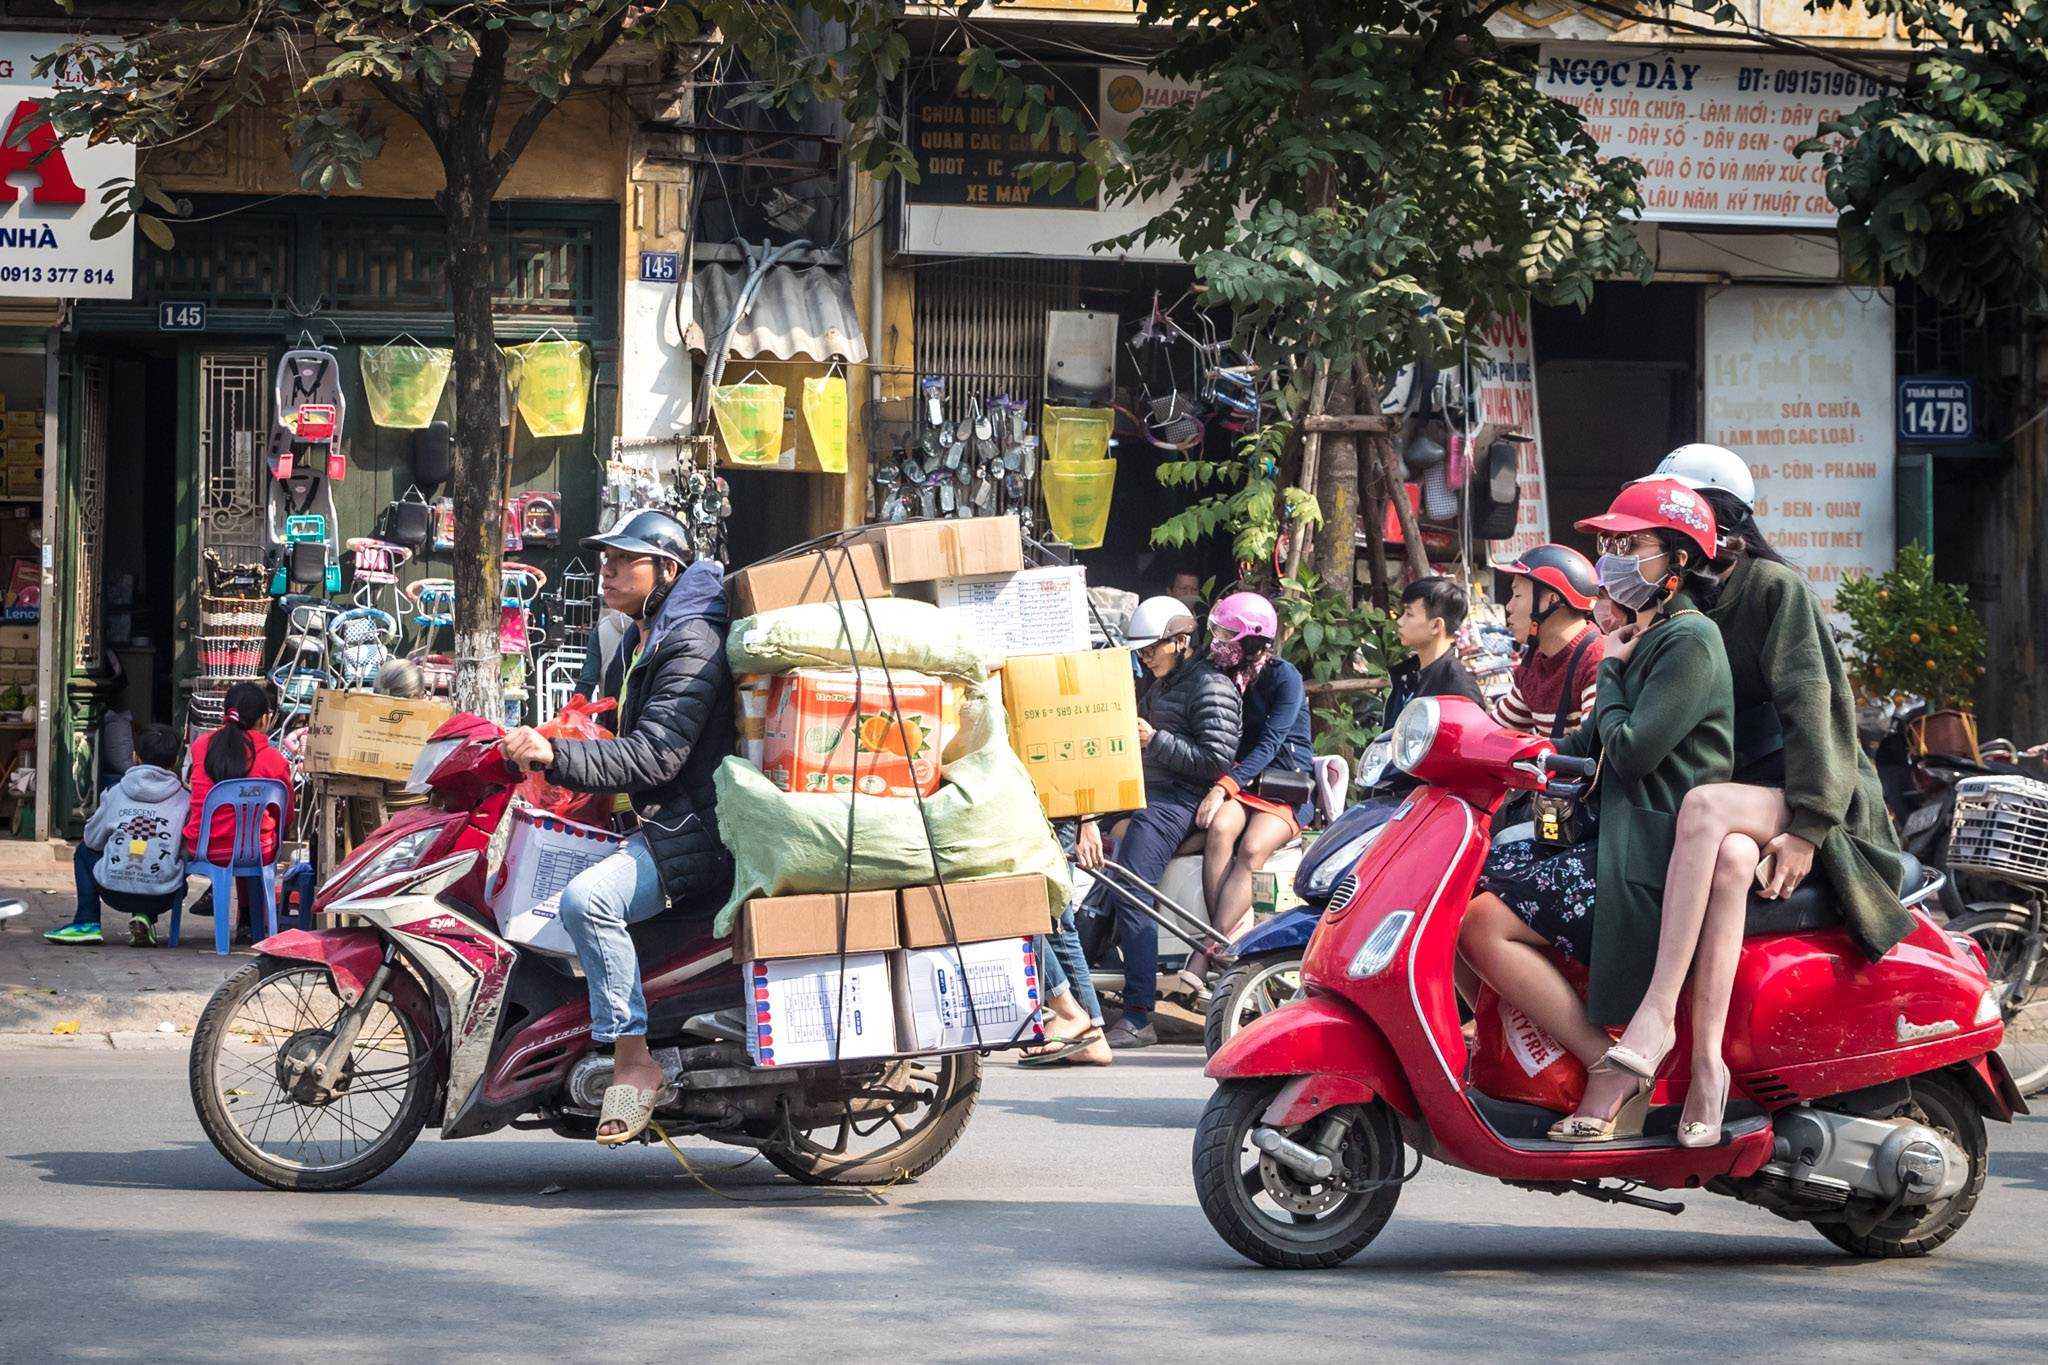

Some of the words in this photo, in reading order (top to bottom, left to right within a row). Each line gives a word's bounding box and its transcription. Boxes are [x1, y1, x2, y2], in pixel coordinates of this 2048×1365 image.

[1547, 57, 1630, 92] NGỌC
[1636, 57, 1701, 92] DÂY
[1609, 91, 1639, 119] SỬA
[1645, 94, 1686, 121] CHỮA
[1699, 99, 1731, 123] LÀM
[1781, 103, 1814, 126] DÂY
[1628, 122, 1659, 146] DÂY
[1664, 120, 1688, 148] SỐ
[1702, 126, 1735, 151] DÂY
[1738, 132, 1770, 151] BEN
[1679, 154, 1692, 179] Ô
[1696, 155, 1717, 180] TÔ
[1719, 155, 1739, 181] VÀ
[1742, 158, 1777, 183] MÁY
[1648, 187, 1680, 208] LÂU
[0, 222, 58, 249] NHÀ
[1, 266, 42, 283] 0913
[47, 267, 79, 284] 377
[84, 269, 115, 285] 814
[641, 255, 676, 277] 145
[164, 307, 203, 327] 145
[1904, 401, 1969, 434] 147B
[1782, 458, 1814, 481] CÔN
[1824, 463, 1878, 480] PHANH
[1782, 501, 1813, 519] BEN
[429, 917, 457, 929] SYM
[1520, 1031, 1550, 1065] FREE
